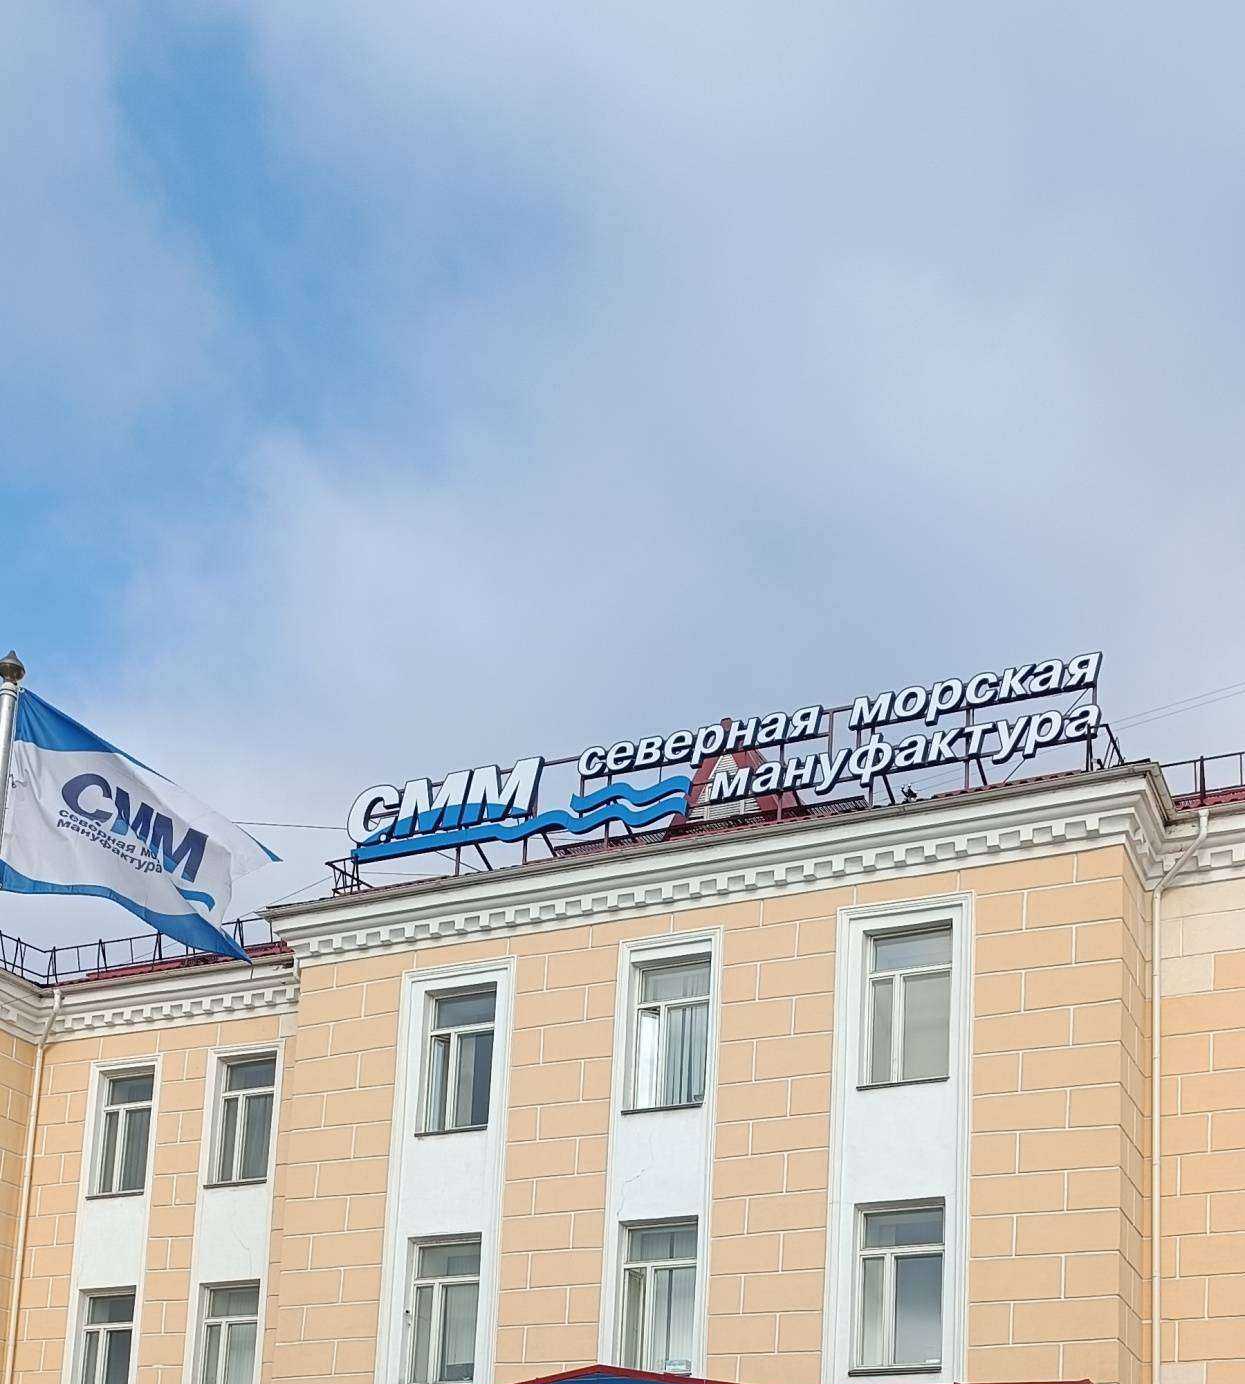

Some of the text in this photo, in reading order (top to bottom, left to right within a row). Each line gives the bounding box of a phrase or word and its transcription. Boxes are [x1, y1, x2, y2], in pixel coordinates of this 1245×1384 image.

[577, 651, 1102, 777] северная морская
[710, 704, 1101, 800] мануфактура
[61, 773, 209, 884] СММ
[347, 756, 546, 845] СММ
